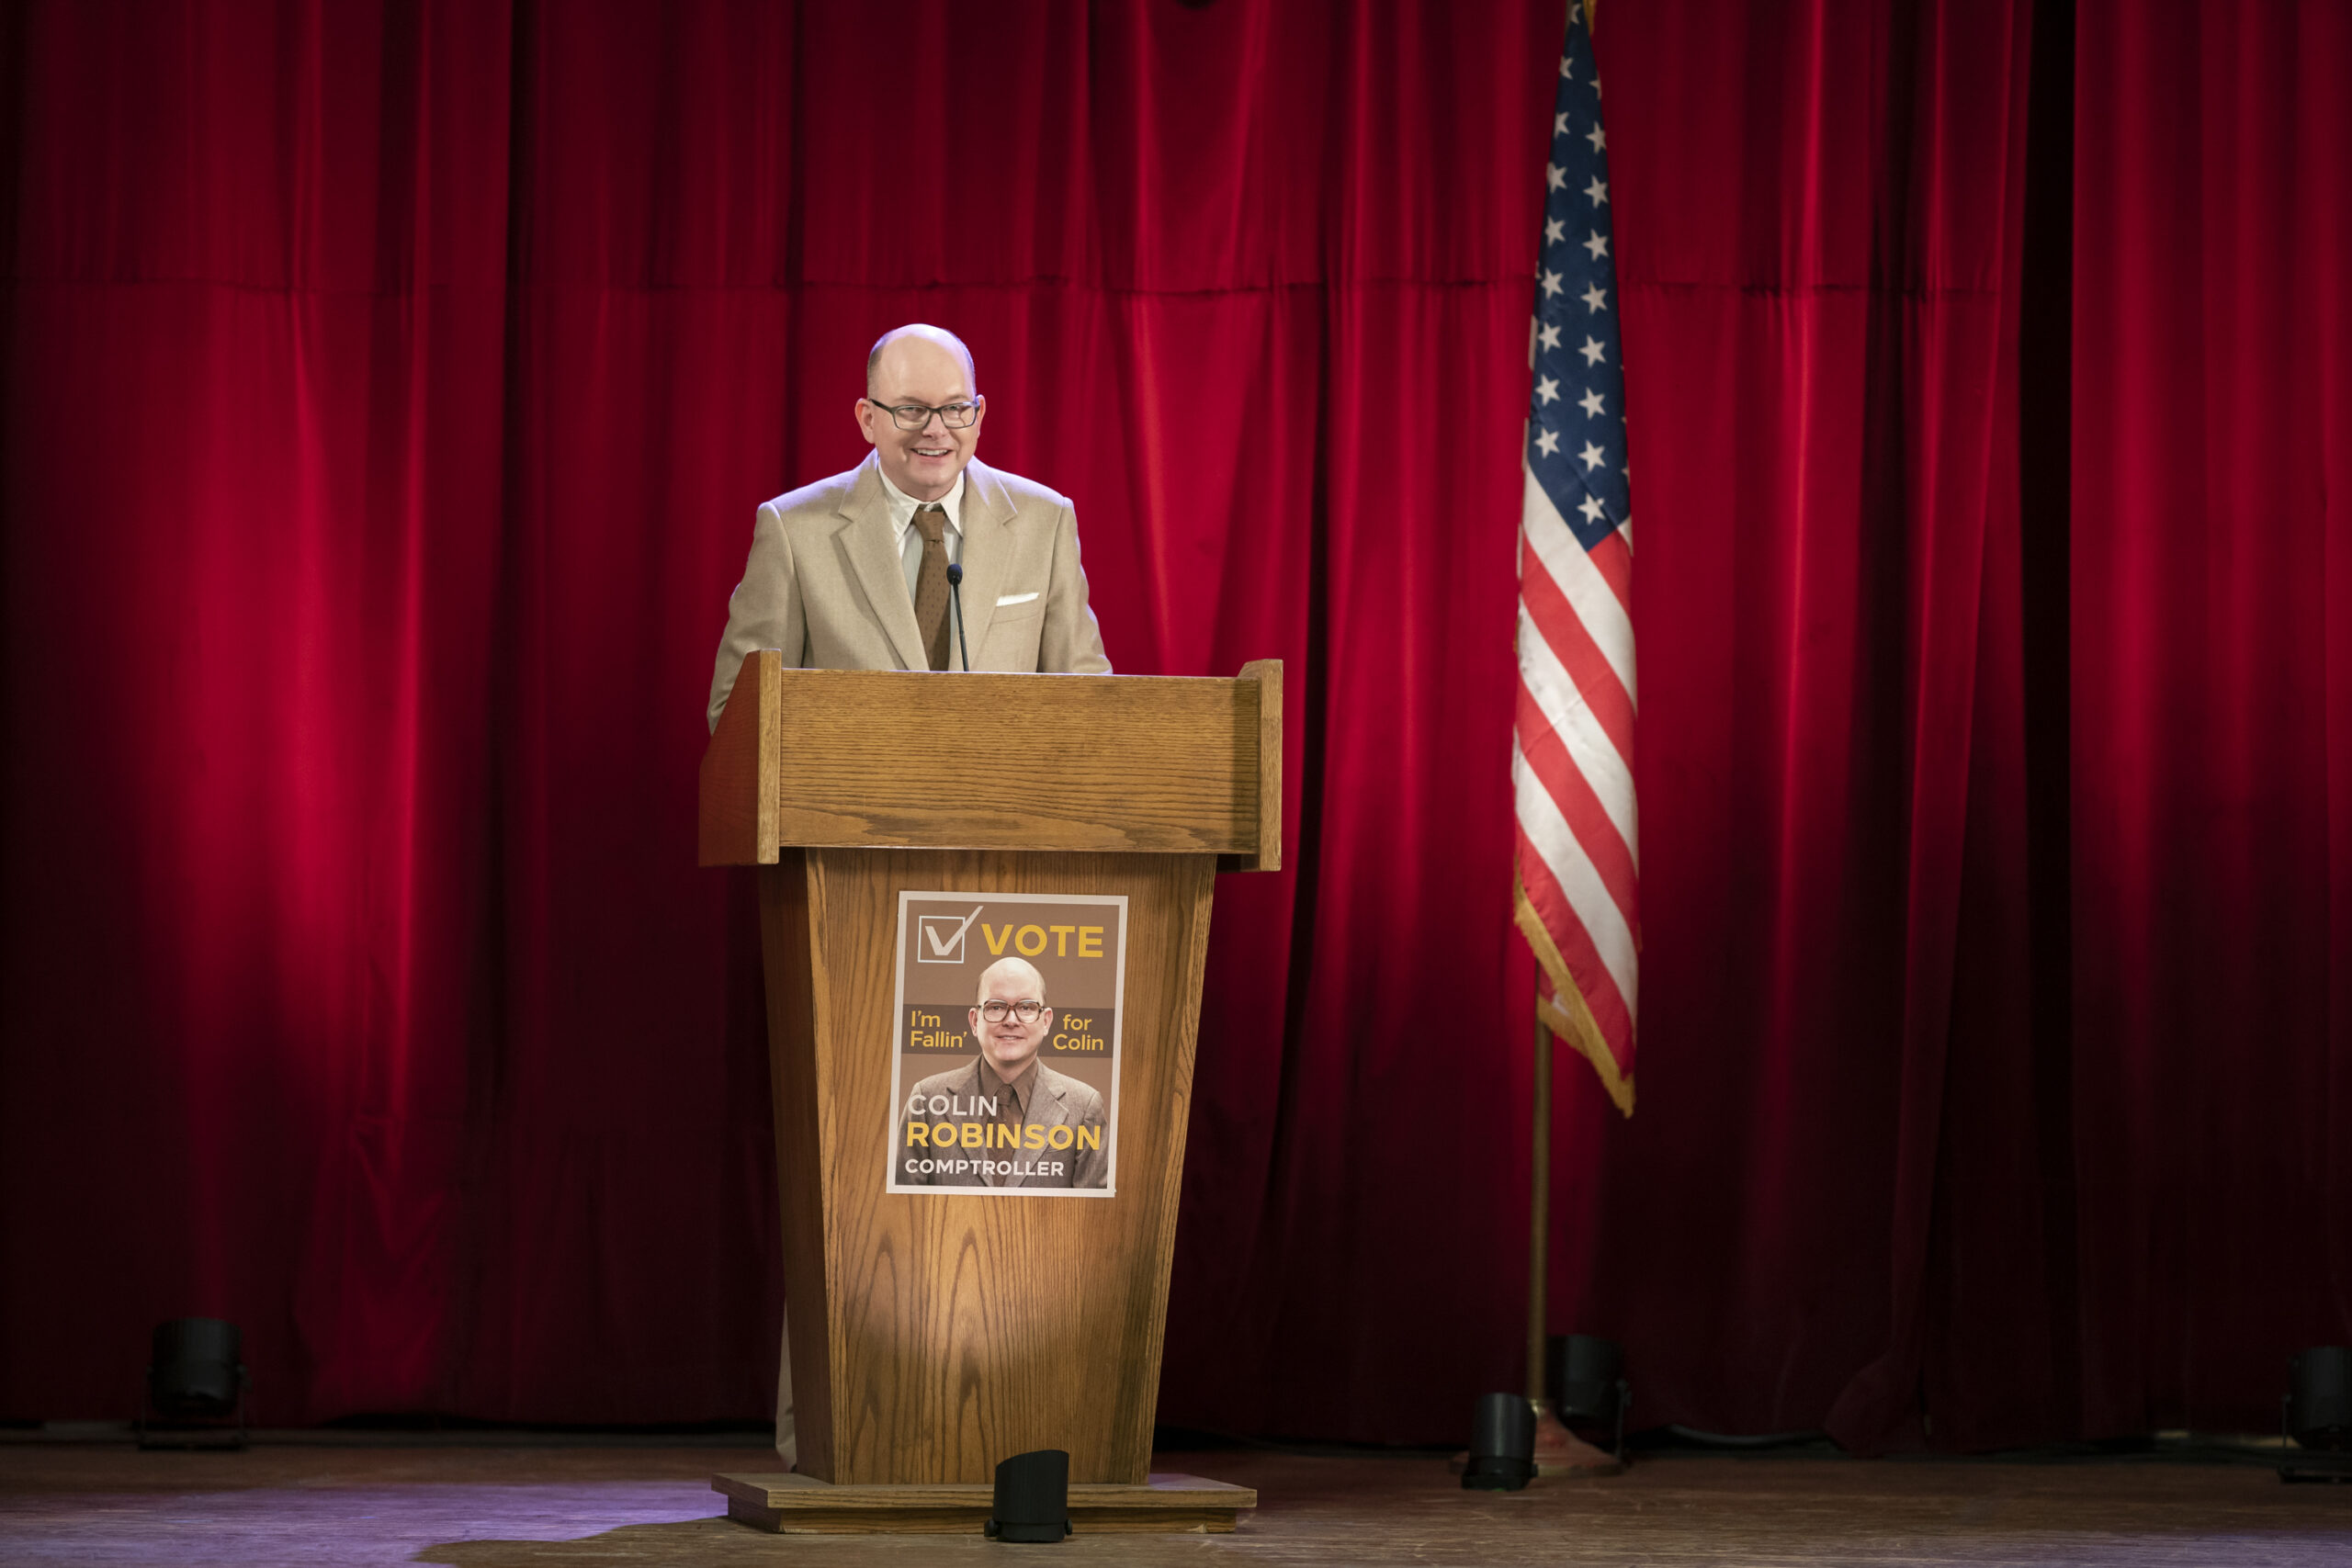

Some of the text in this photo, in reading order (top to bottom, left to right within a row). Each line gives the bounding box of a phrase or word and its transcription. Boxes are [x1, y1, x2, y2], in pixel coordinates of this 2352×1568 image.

[981, 923, 1104, 958] VOTE
[910, 1010, 940, 1027] I'm
[1062, 1013, 1092, 1031] for
[910, 1031, 967, 1048] Fallin'
[1053, 1033, 1103, 1051] Colin
[908, 1095, 998, 1116] COLIN
[906, 1122, 1101, 1150] ROBINSON
[905, 1158, 1065, 1177] COMPTROLLER
